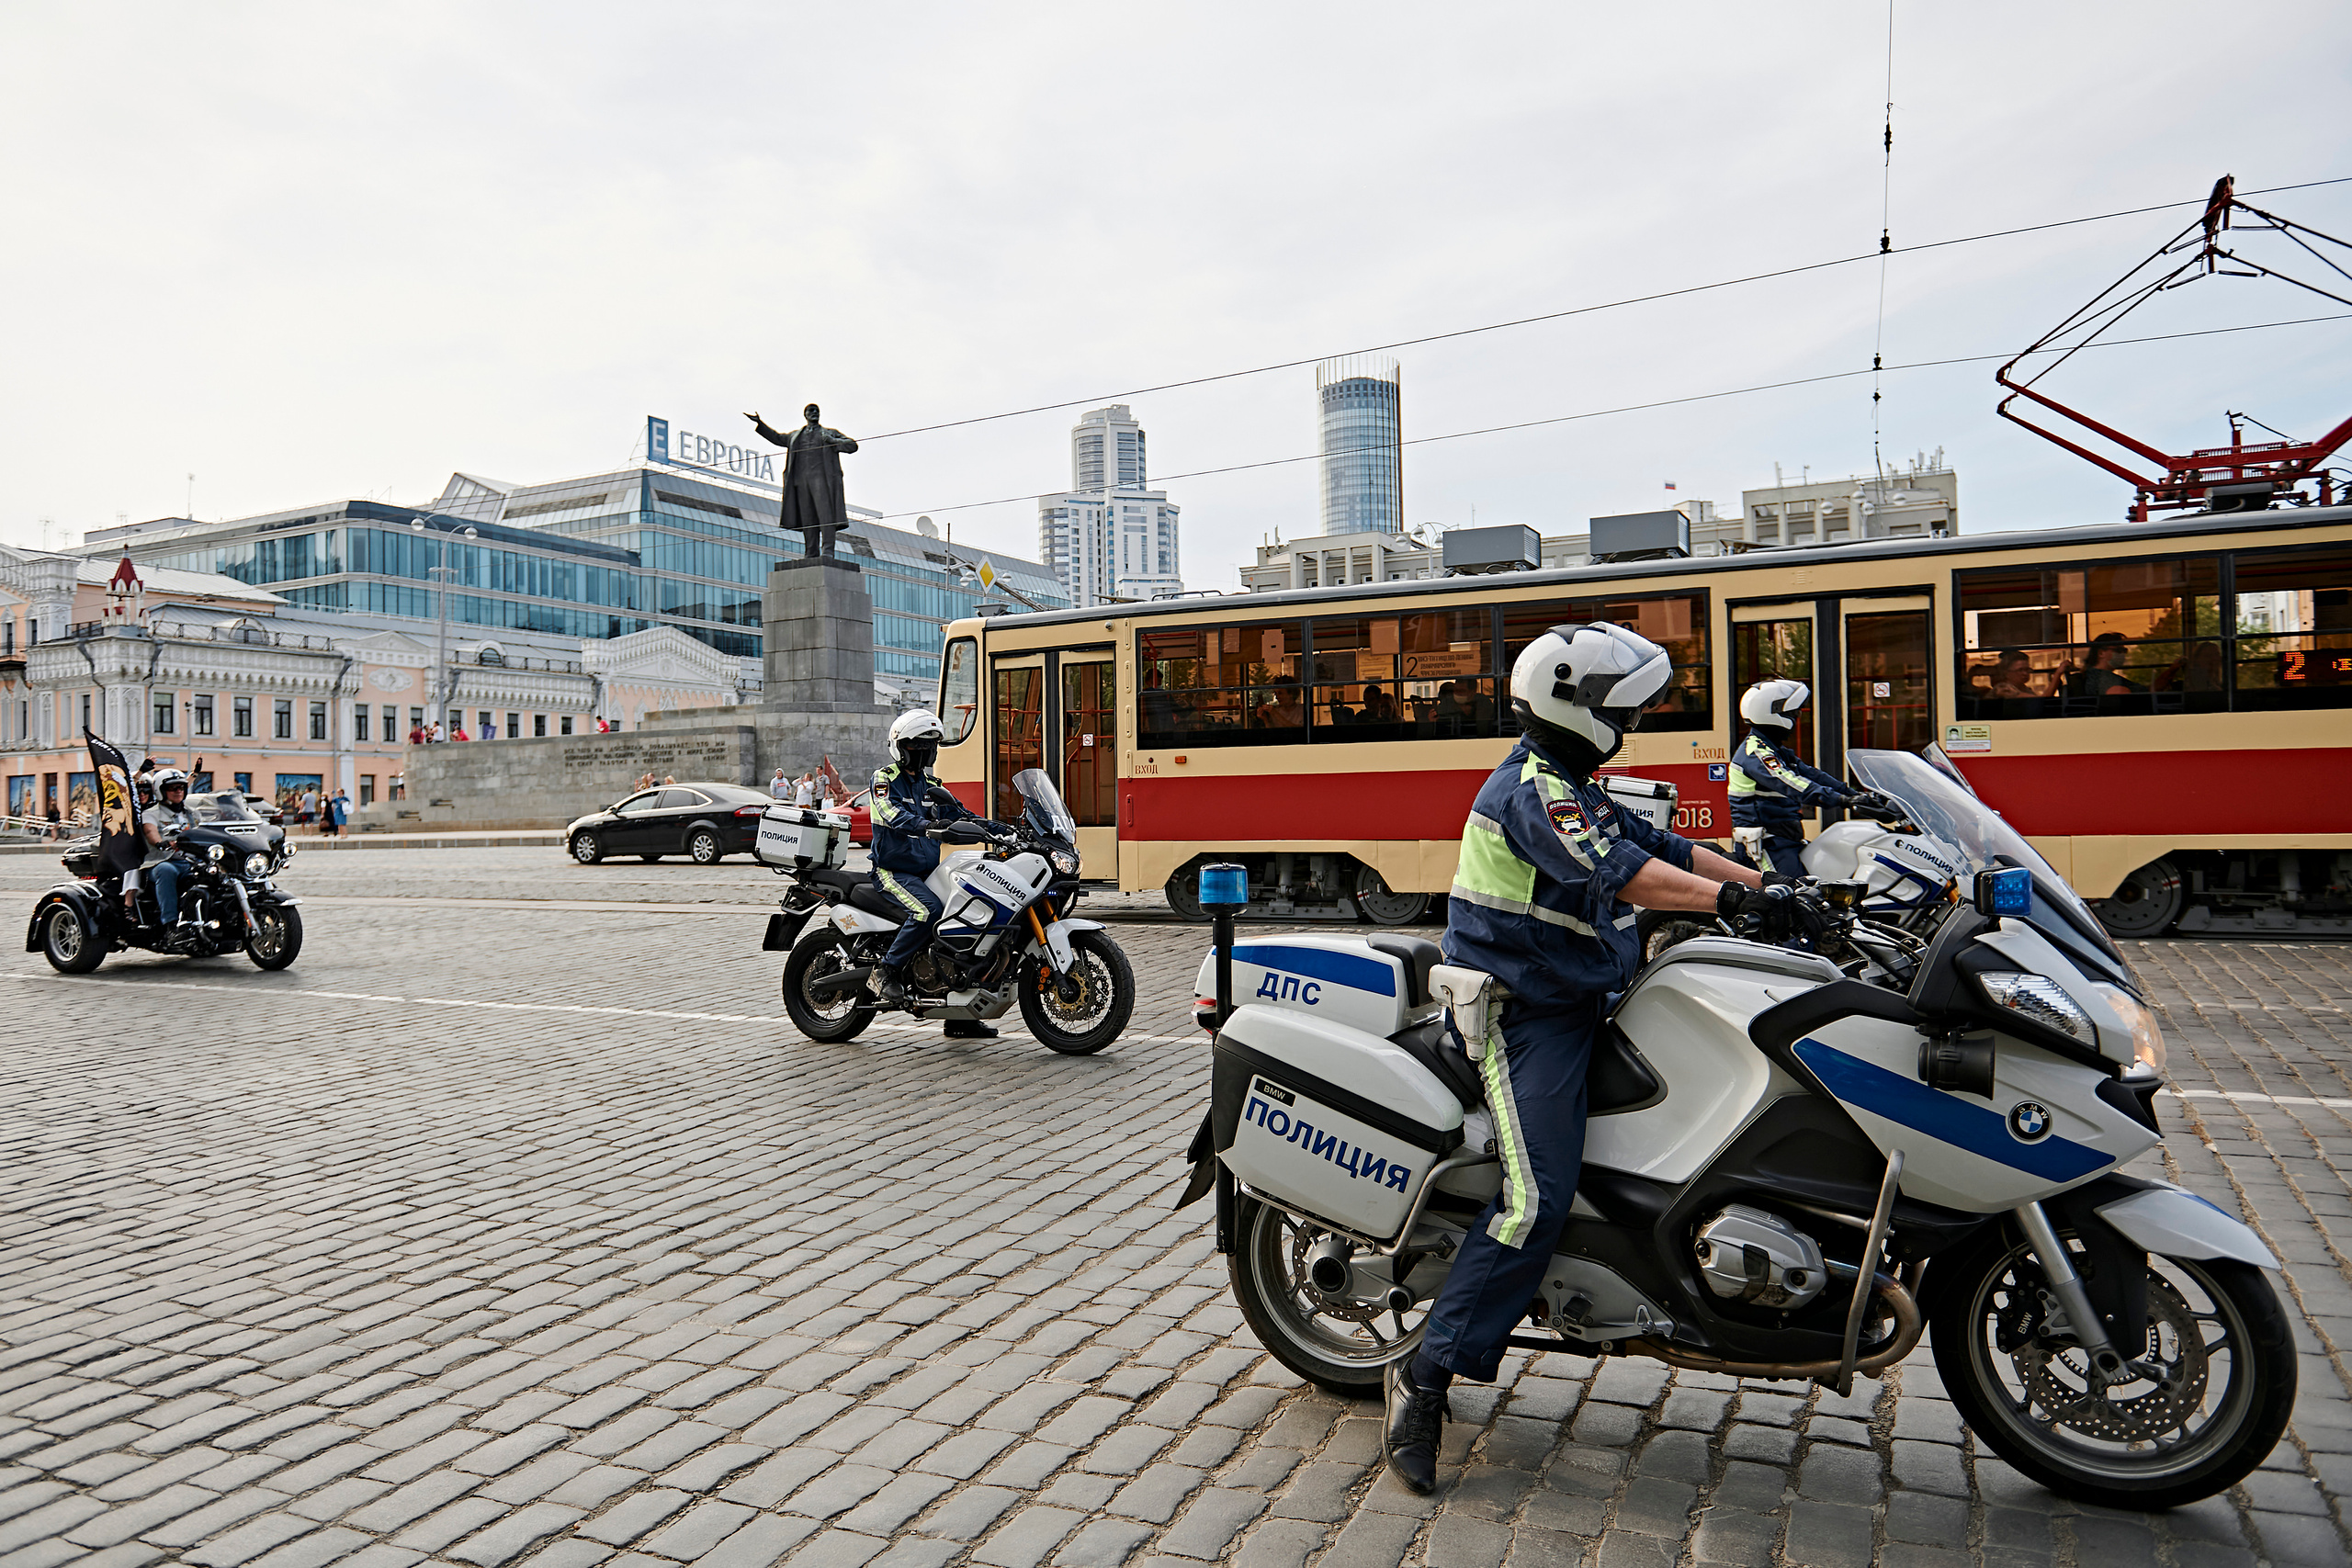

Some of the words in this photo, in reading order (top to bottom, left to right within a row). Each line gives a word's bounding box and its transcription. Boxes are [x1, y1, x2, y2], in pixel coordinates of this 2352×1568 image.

[680, 430, 775, 482] ЕВРОПА
[1406, 656, 1419, 678] 2
[2283, 651, 2306, 680] 2
[1692, 748, 1725, 760] ВХОД
[1135, 764, 1159, 774] ВХОД
[761, 829, 798, 845] ПОЛИЦИЯ
[1905, 842, 1954, 874] ПОЛИЦИЯ
[982, 867, 1027, 901] ПОЛИЦИЯ
[1256, 971, 1322, 1006] ДПС
[1263, 1084, 1286, 1100] BMW
[1245, 1095, 1412, 1194] ПОЛИЦИЯ
[2017, 1312, 2032, 1335] BMW
